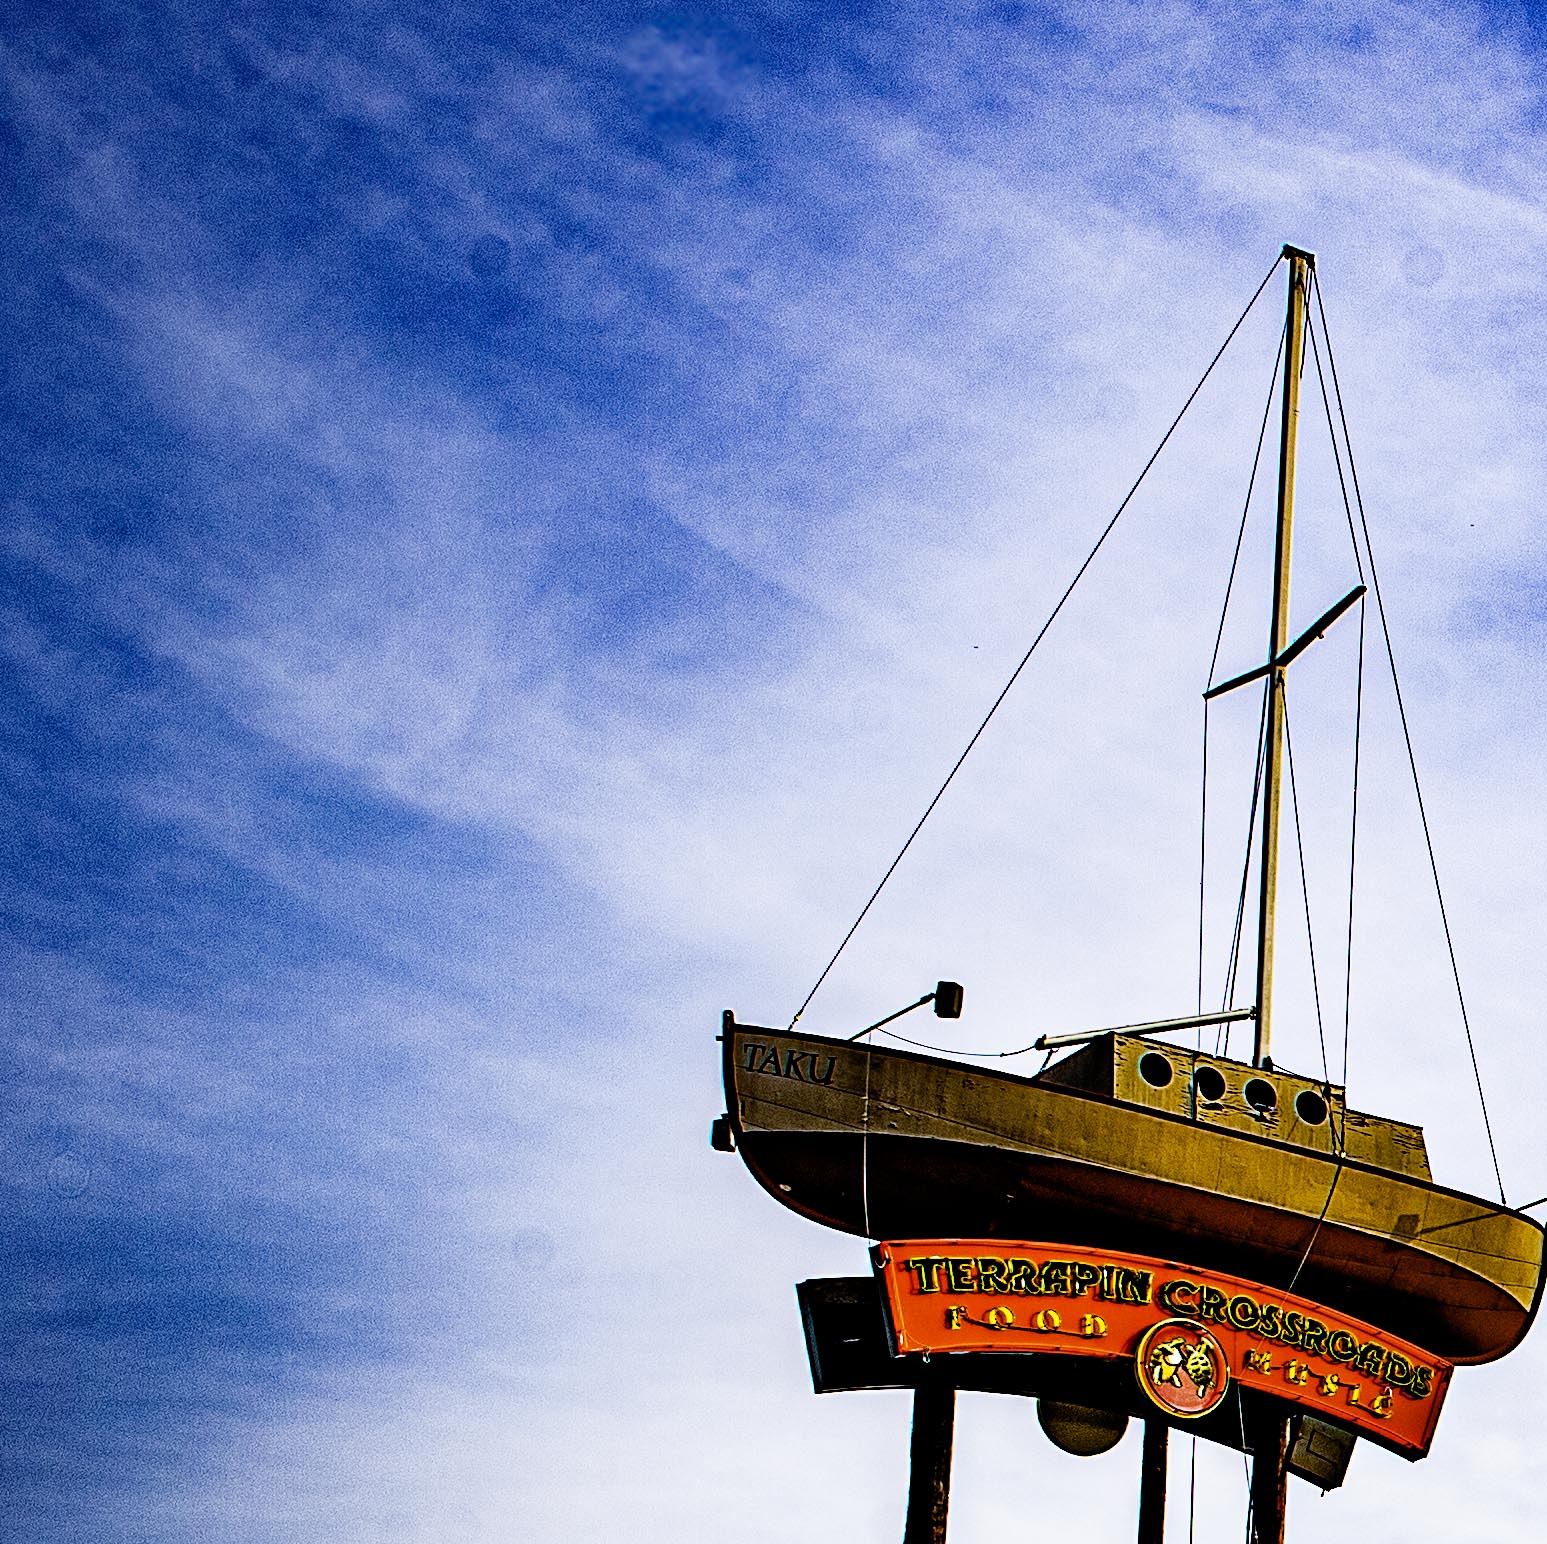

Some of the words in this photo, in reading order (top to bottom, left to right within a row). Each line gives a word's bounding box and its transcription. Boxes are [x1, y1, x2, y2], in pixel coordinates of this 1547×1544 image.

[742, 1042, 838, 1086] TAKU
[908, 1255, 1153, 1304] TERRAPIN
[1160, 1279, 1435, 1397] CROSSROADS
[947, 1304, 1108, 1337] FOOD
[1249, 1348, 1393, 1419] MUSIC
